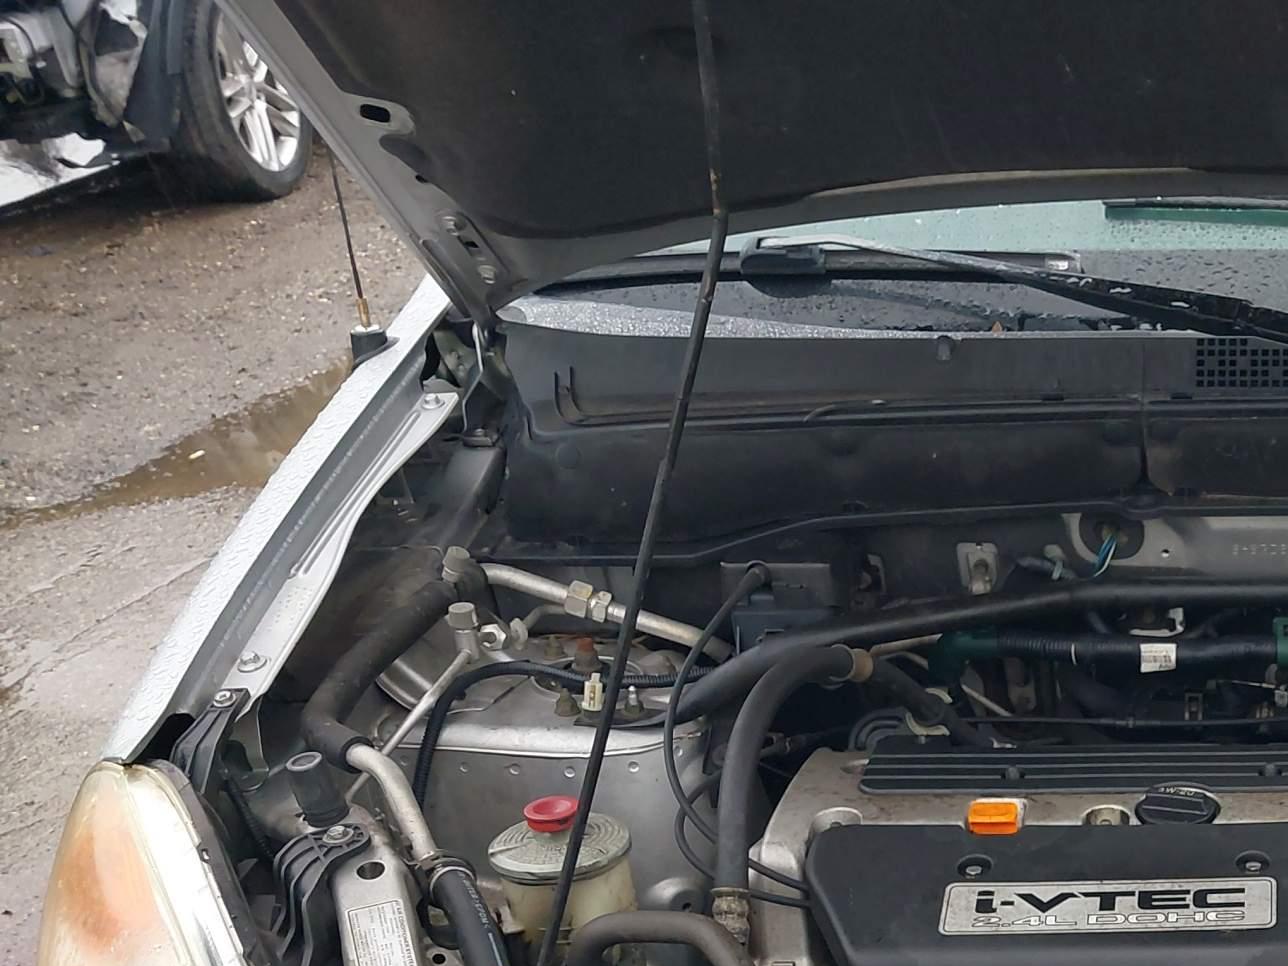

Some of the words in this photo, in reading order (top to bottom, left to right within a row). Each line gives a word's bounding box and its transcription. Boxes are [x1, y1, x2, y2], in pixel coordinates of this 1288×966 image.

[975, 888, 1246, 914] i-VTEC
[971, 914, 1078, 928] 2.4L
[1087, 910, 1246, 926] DOHC
